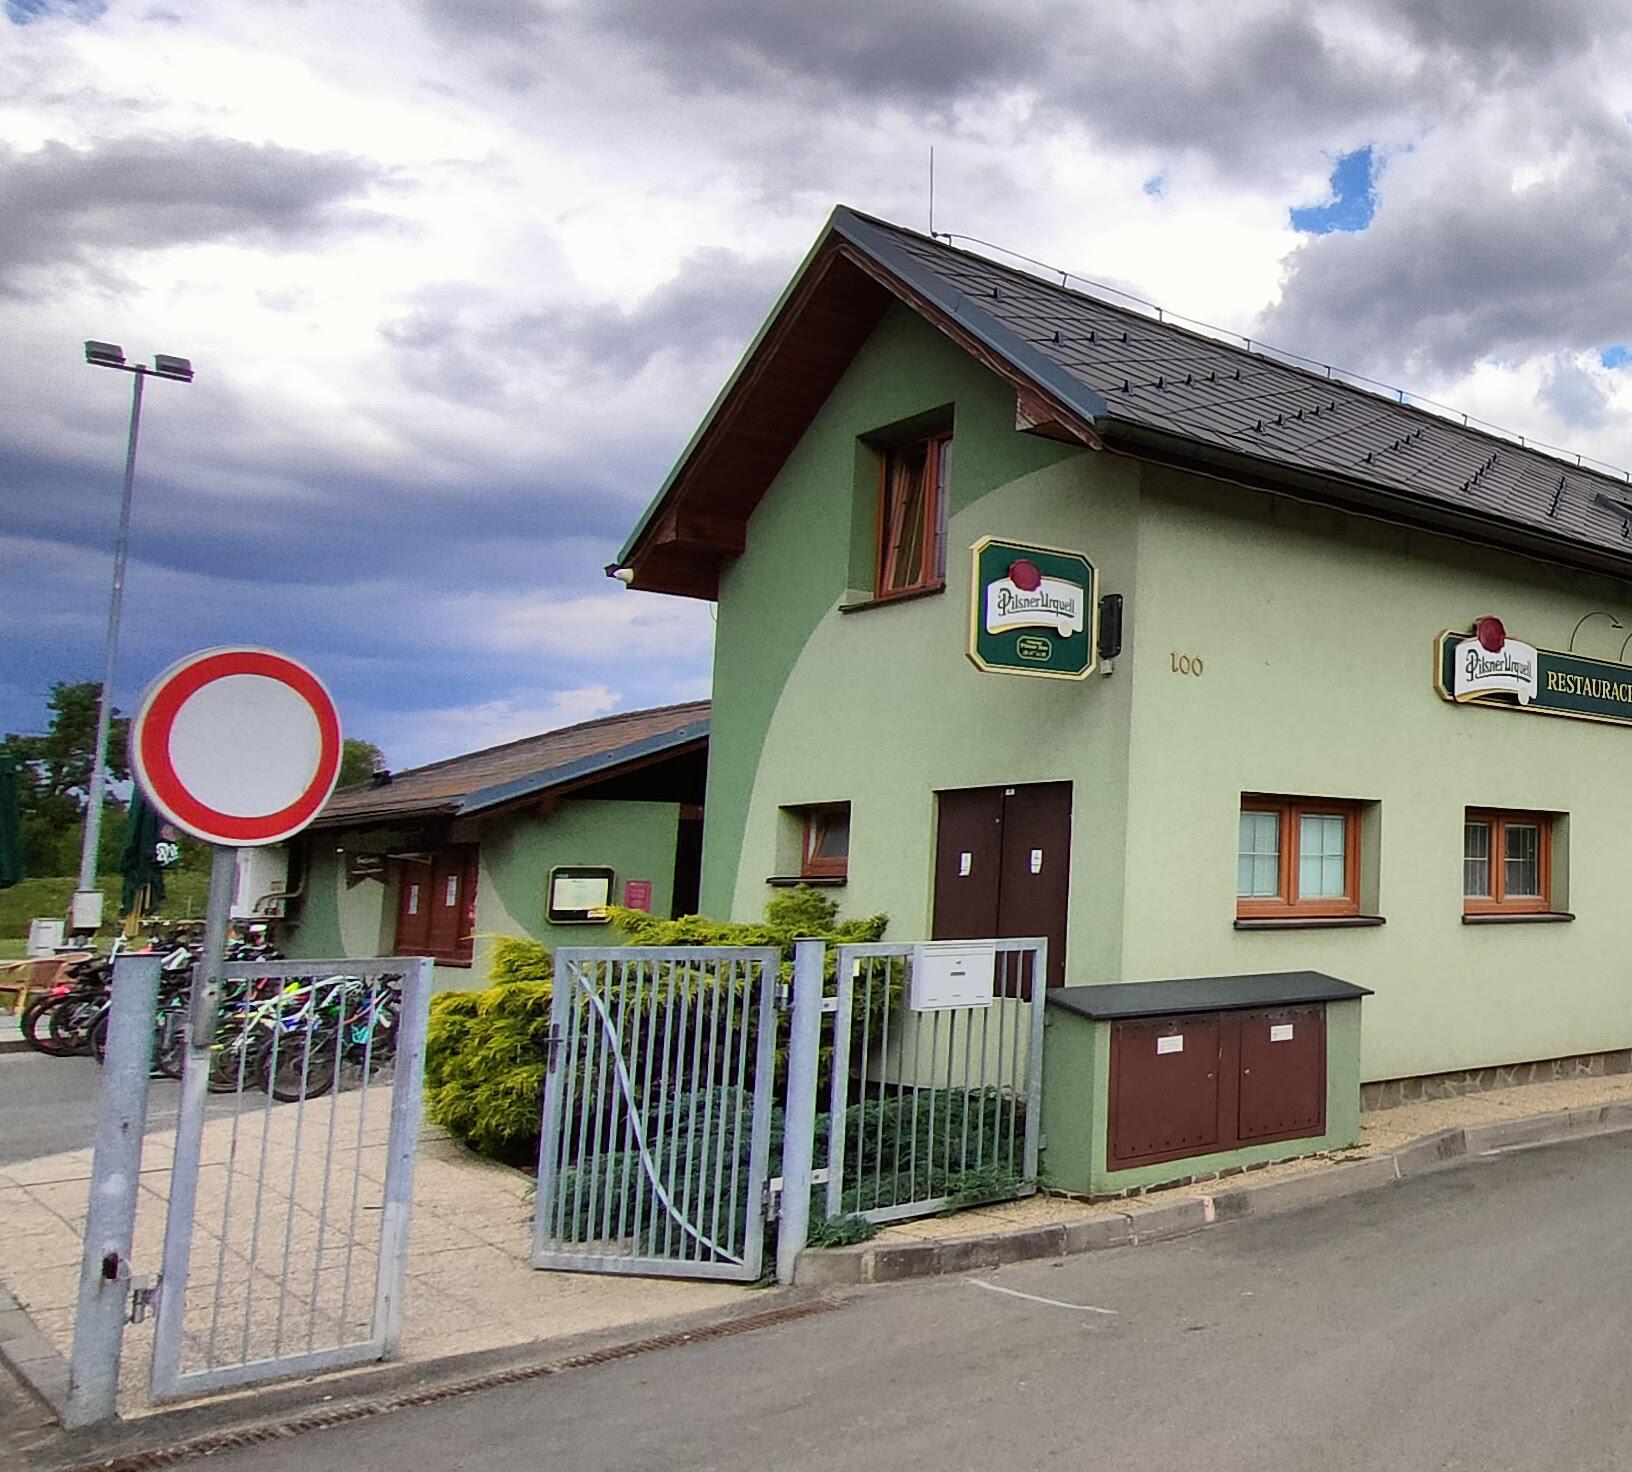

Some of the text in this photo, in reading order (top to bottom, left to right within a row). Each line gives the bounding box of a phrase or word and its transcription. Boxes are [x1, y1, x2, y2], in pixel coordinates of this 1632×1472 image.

[997, 587, 1075, 617] Pilsner Urquell
[1170, 652, 1203, 677] 100
[1465, 648, 1504, 682] Pilsner
